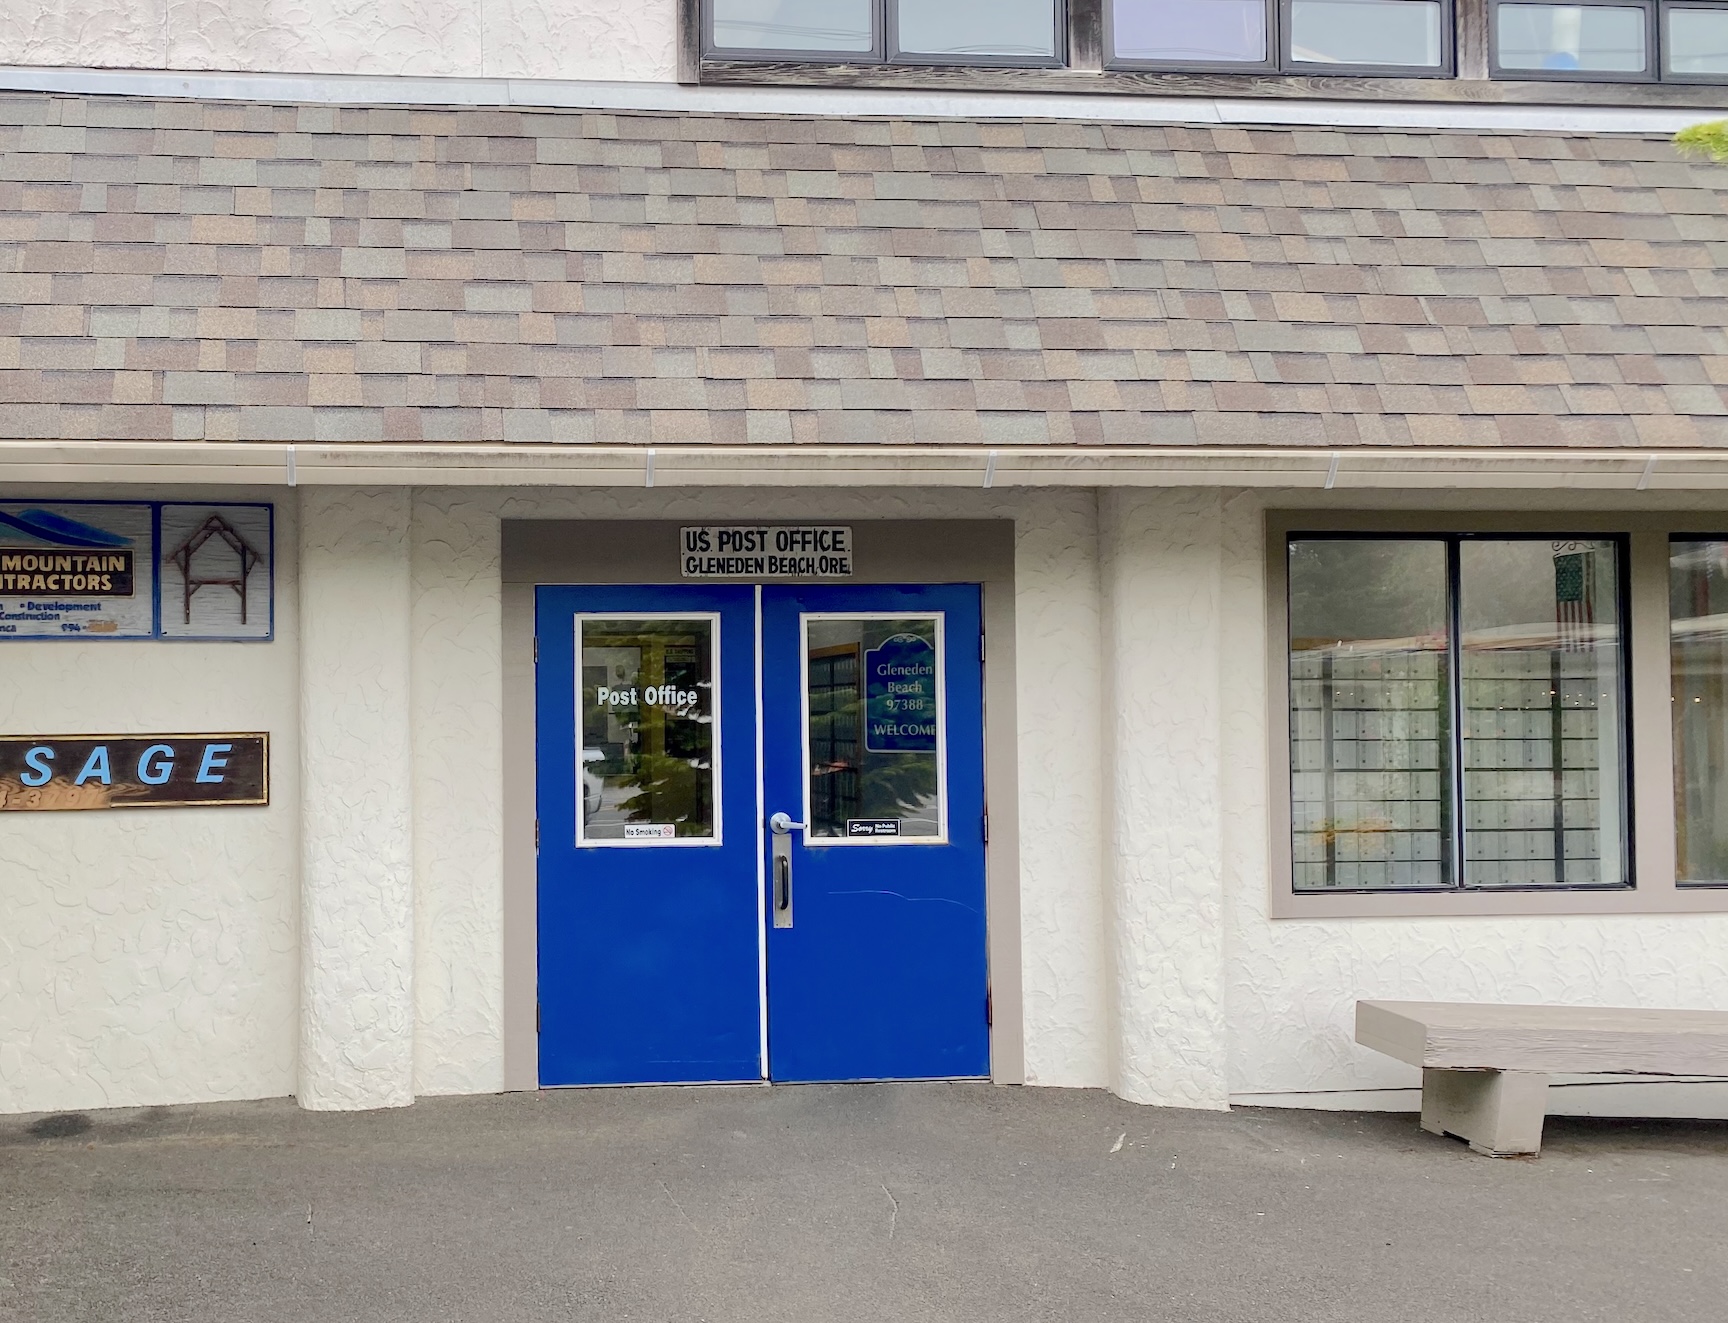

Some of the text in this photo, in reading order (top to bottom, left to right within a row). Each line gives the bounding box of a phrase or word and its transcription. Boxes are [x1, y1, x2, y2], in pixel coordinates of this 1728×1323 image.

[718, 530, 768, 552] POST
[1, 554, 126, 573] MOUNTAIN
[685, 556, 765, 574] GLENEDEN
[0, 573, 113, 591] TRACTORS
[27, 601, 102, 613] Development
[0, 611, 60, 621] Construction
[877, 663, 934, 676] Gleneden
[887, 680, 923, 693] Beach
[597, 684, 698, 706] Post Office
[886, 699, 924, 711] 97388
[873, 724, 936, 736] WELCOME
[635, 828, 662, 837] Smoking
[851, 823, 874, 834] Sorry
